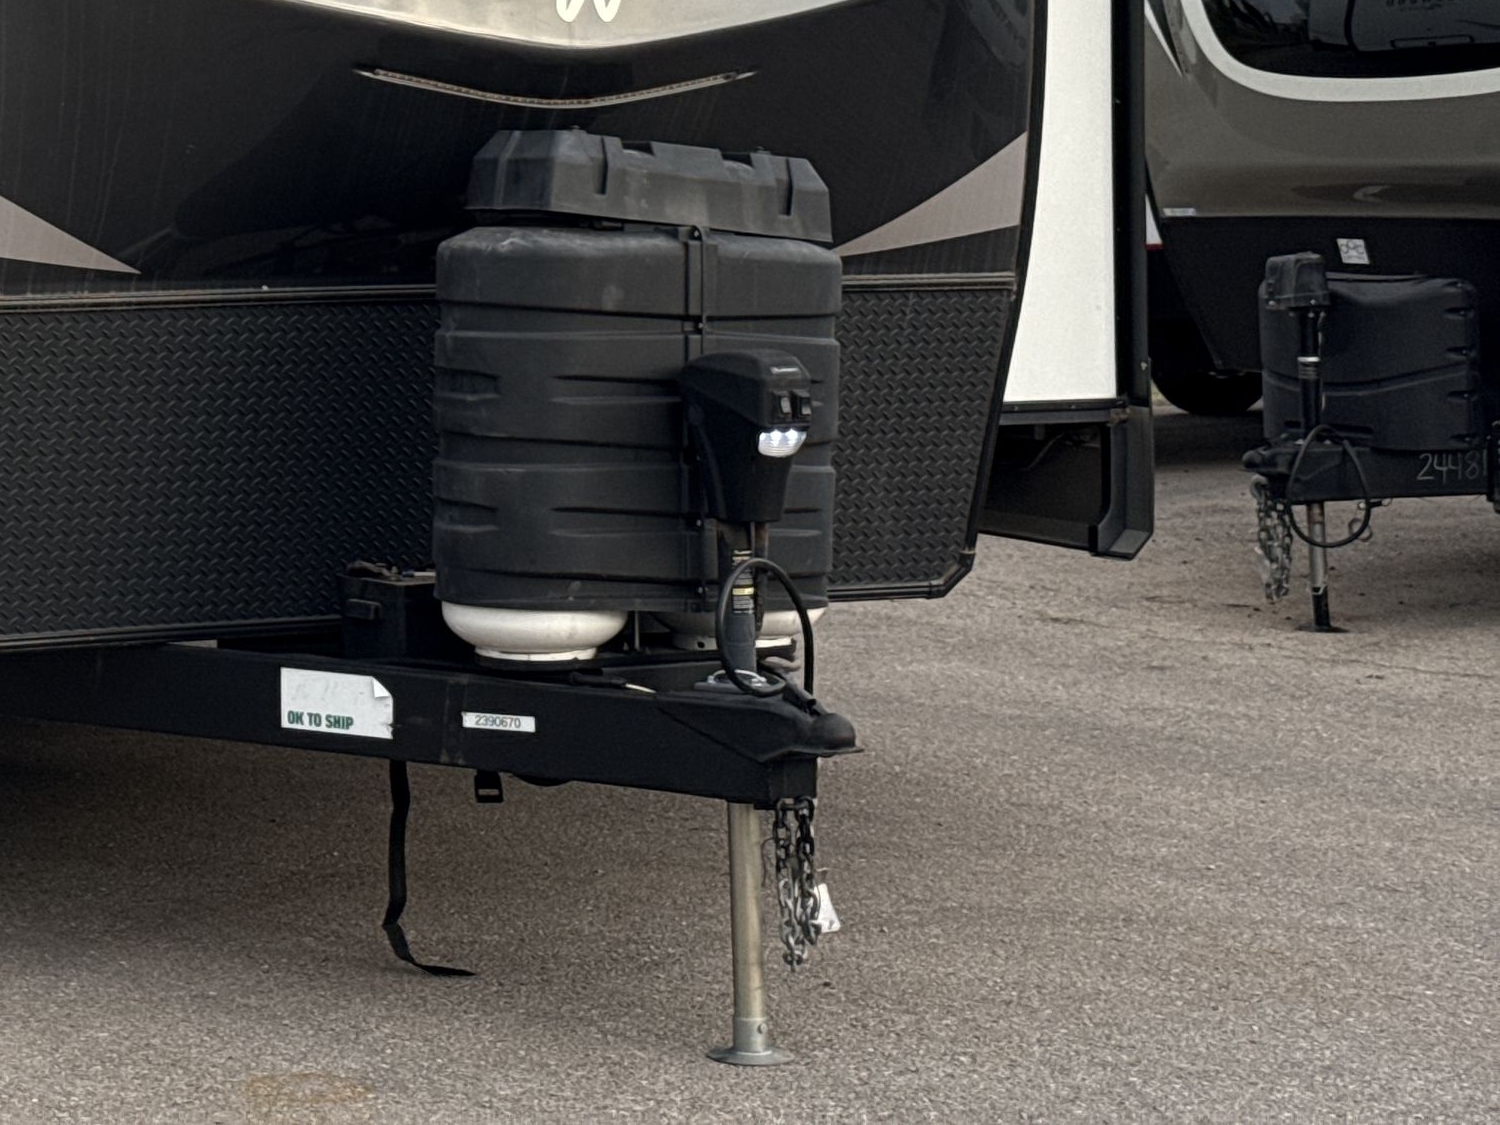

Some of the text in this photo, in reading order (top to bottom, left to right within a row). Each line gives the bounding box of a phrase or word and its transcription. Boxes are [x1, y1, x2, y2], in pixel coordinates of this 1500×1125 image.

[287, 710, 354, 730] OK TO SHIP
[475, 715, 521, 729] 2390670
